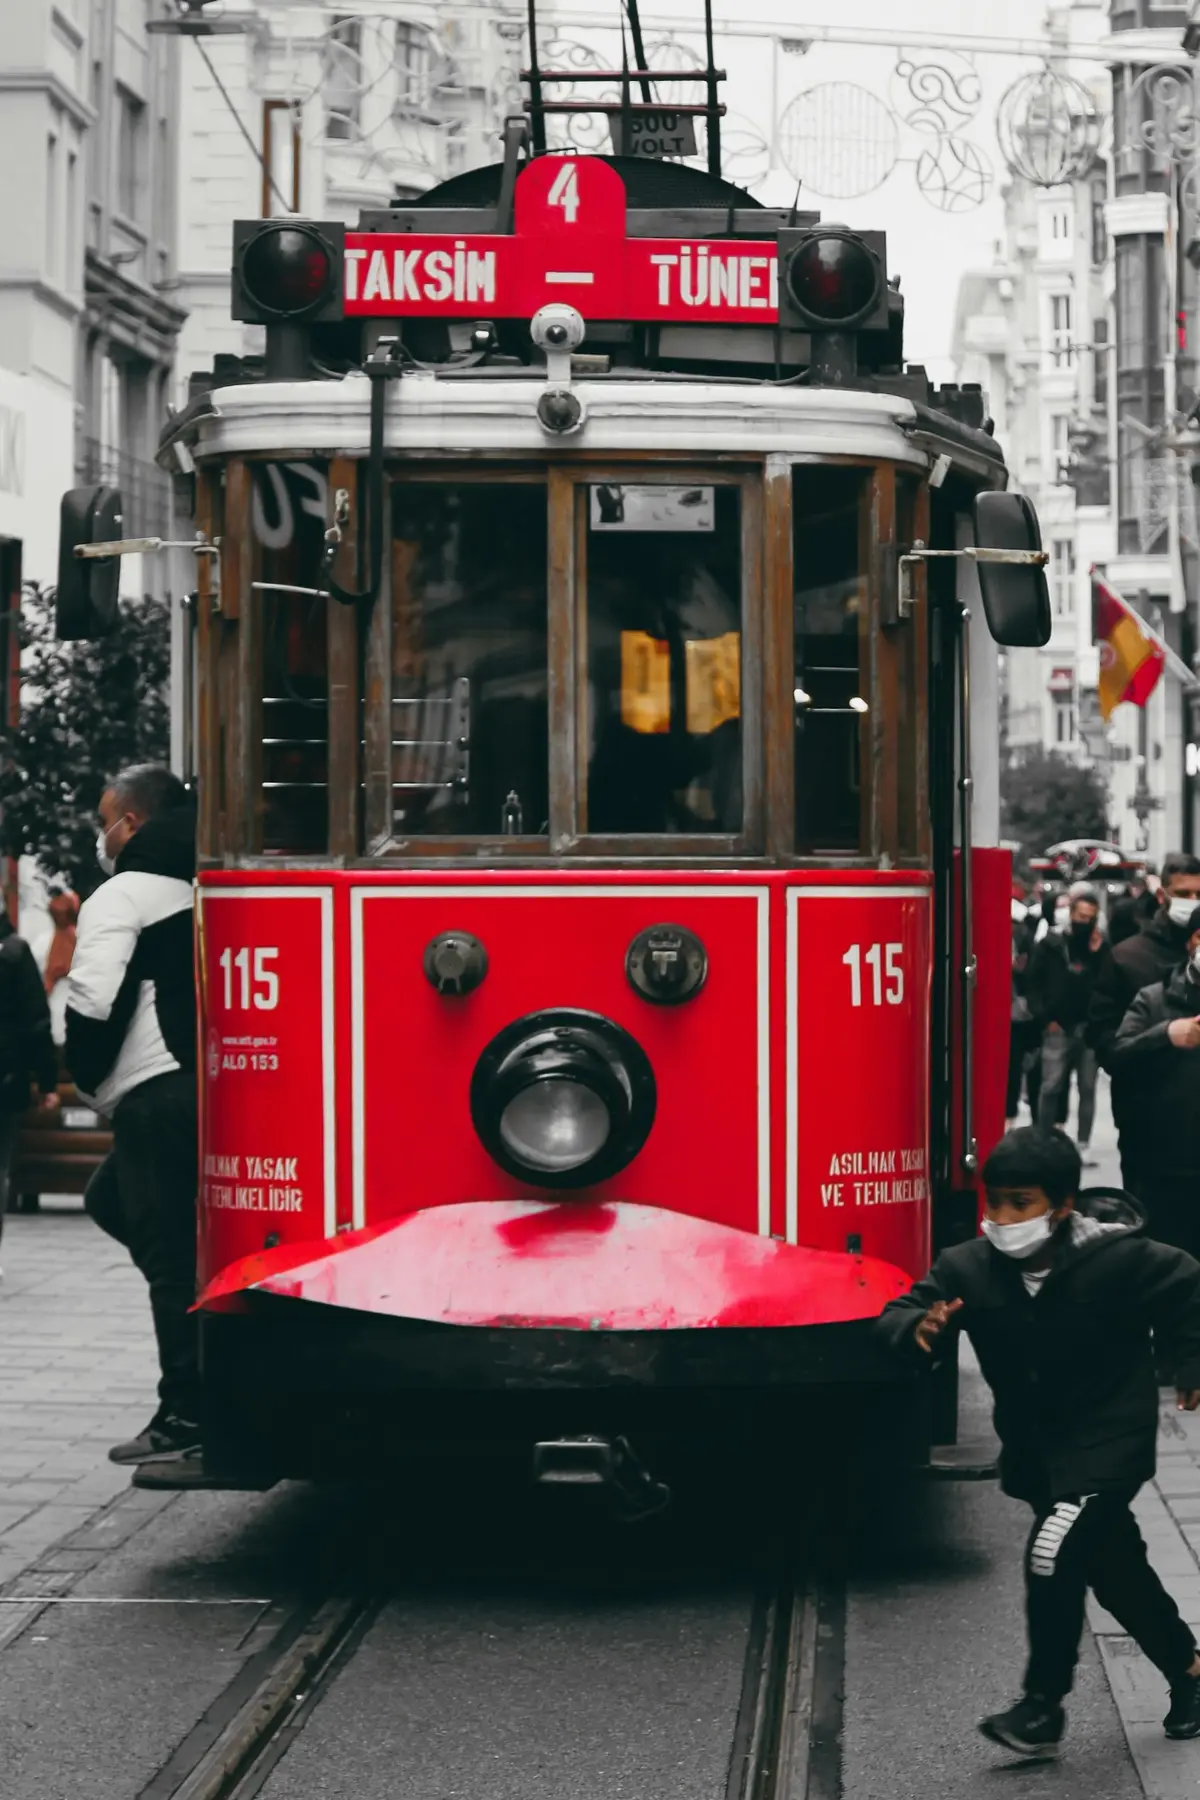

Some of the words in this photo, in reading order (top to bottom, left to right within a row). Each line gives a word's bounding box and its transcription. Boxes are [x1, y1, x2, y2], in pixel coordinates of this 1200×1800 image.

[547, 163, 580, 223] 4
[344, 240, 495, 303] TAKSİM
[219, 946, 279, 1010] 115
[842, 943, 904, 1007] 115
[251, 1054, 279, 1070] 153
[245, 1156, 299, 1181] YASAK
[829, 1150, 896, 1176] ASILMAK
[820, 1182, 845, 1208] VE
